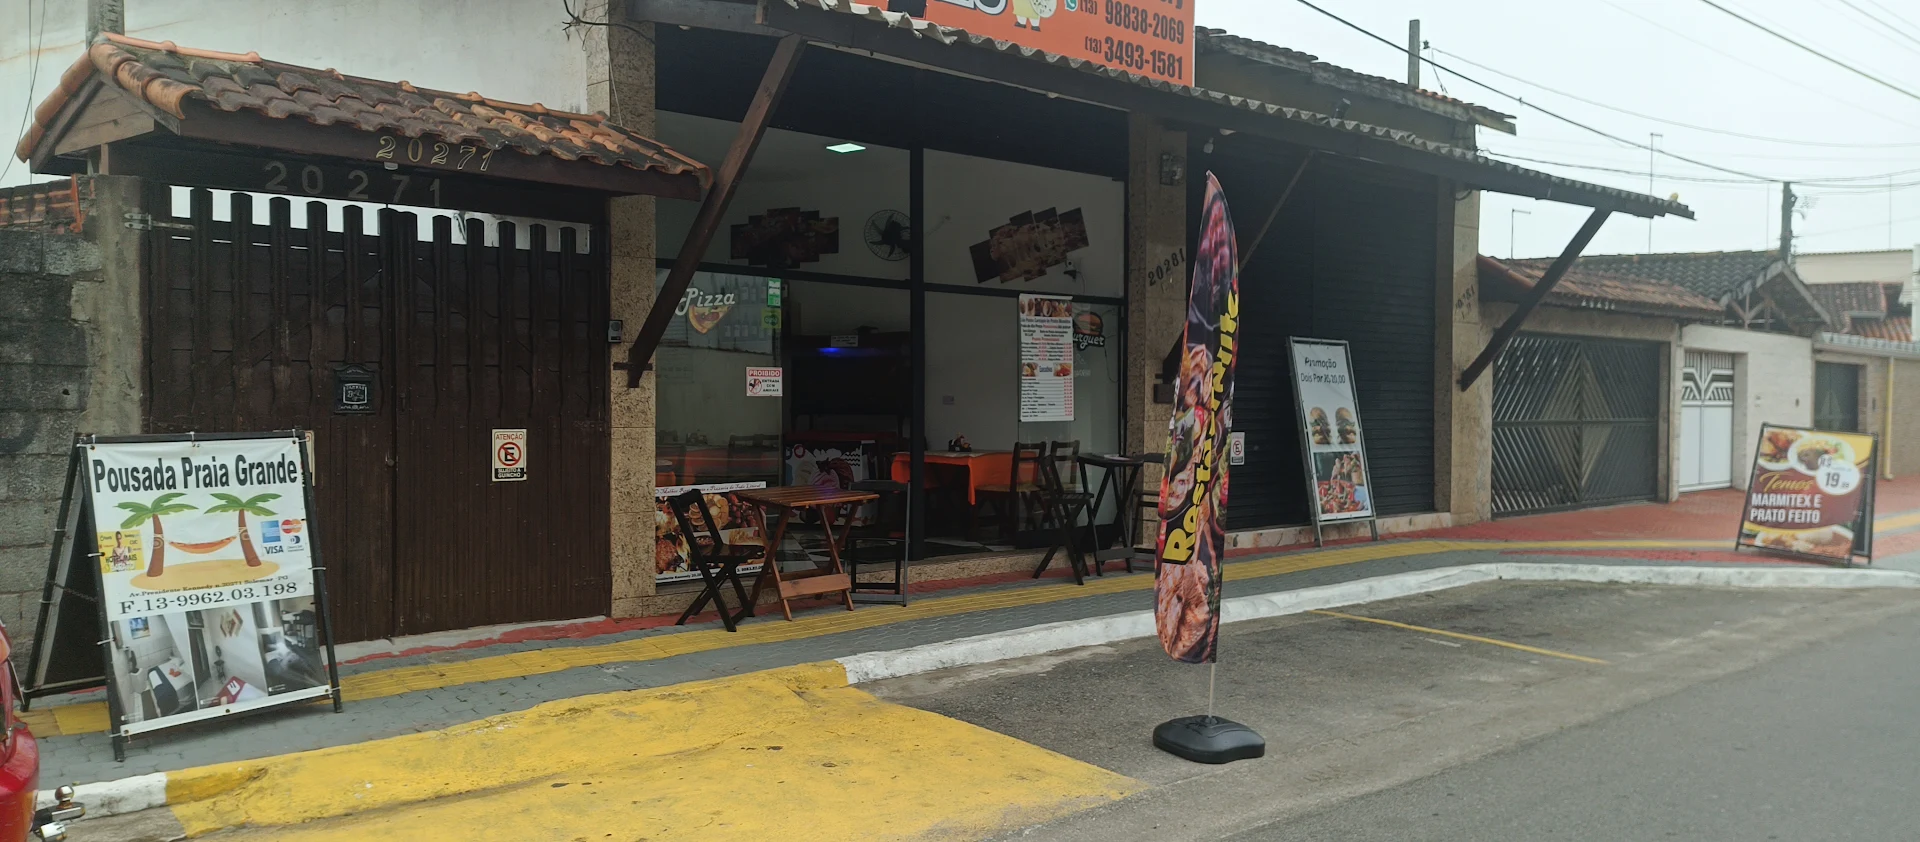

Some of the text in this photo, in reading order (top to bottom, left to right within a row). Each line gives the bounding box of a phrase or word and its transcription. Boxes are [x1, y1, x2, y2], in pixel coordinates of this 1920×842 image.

[1105, 0, 1185, 45] 98838-2069
[1084, 36, 1183, 80] (13) 3493-1581
[375, 135, 494, 172] 20271
[263, 161, 441, 207] 20271
[1148, 248, 1185, 286] 20281
[675, 287, 736, 316] Pizza
[1073, 333, 1105, 349] urguer
[1300, 373, 1313, 382] Dois
[1304, 356, 1337, 370] Promoção
[495, 433, 523, 441] ATENÇÃO
[1162, 289, 1239, 561] Restarante
[92, 453, 298, 493] Pousada Praia Grande
[1759, 472, 1814, 493] Temos
[1752, 493, 1823, 508] MARMITEX E
[1750, 508, 1821, 523] PRATO FEITO
[264, 546, 284, 554] VISA
[119, 582, 298, 614] F.13-9962.03.198
